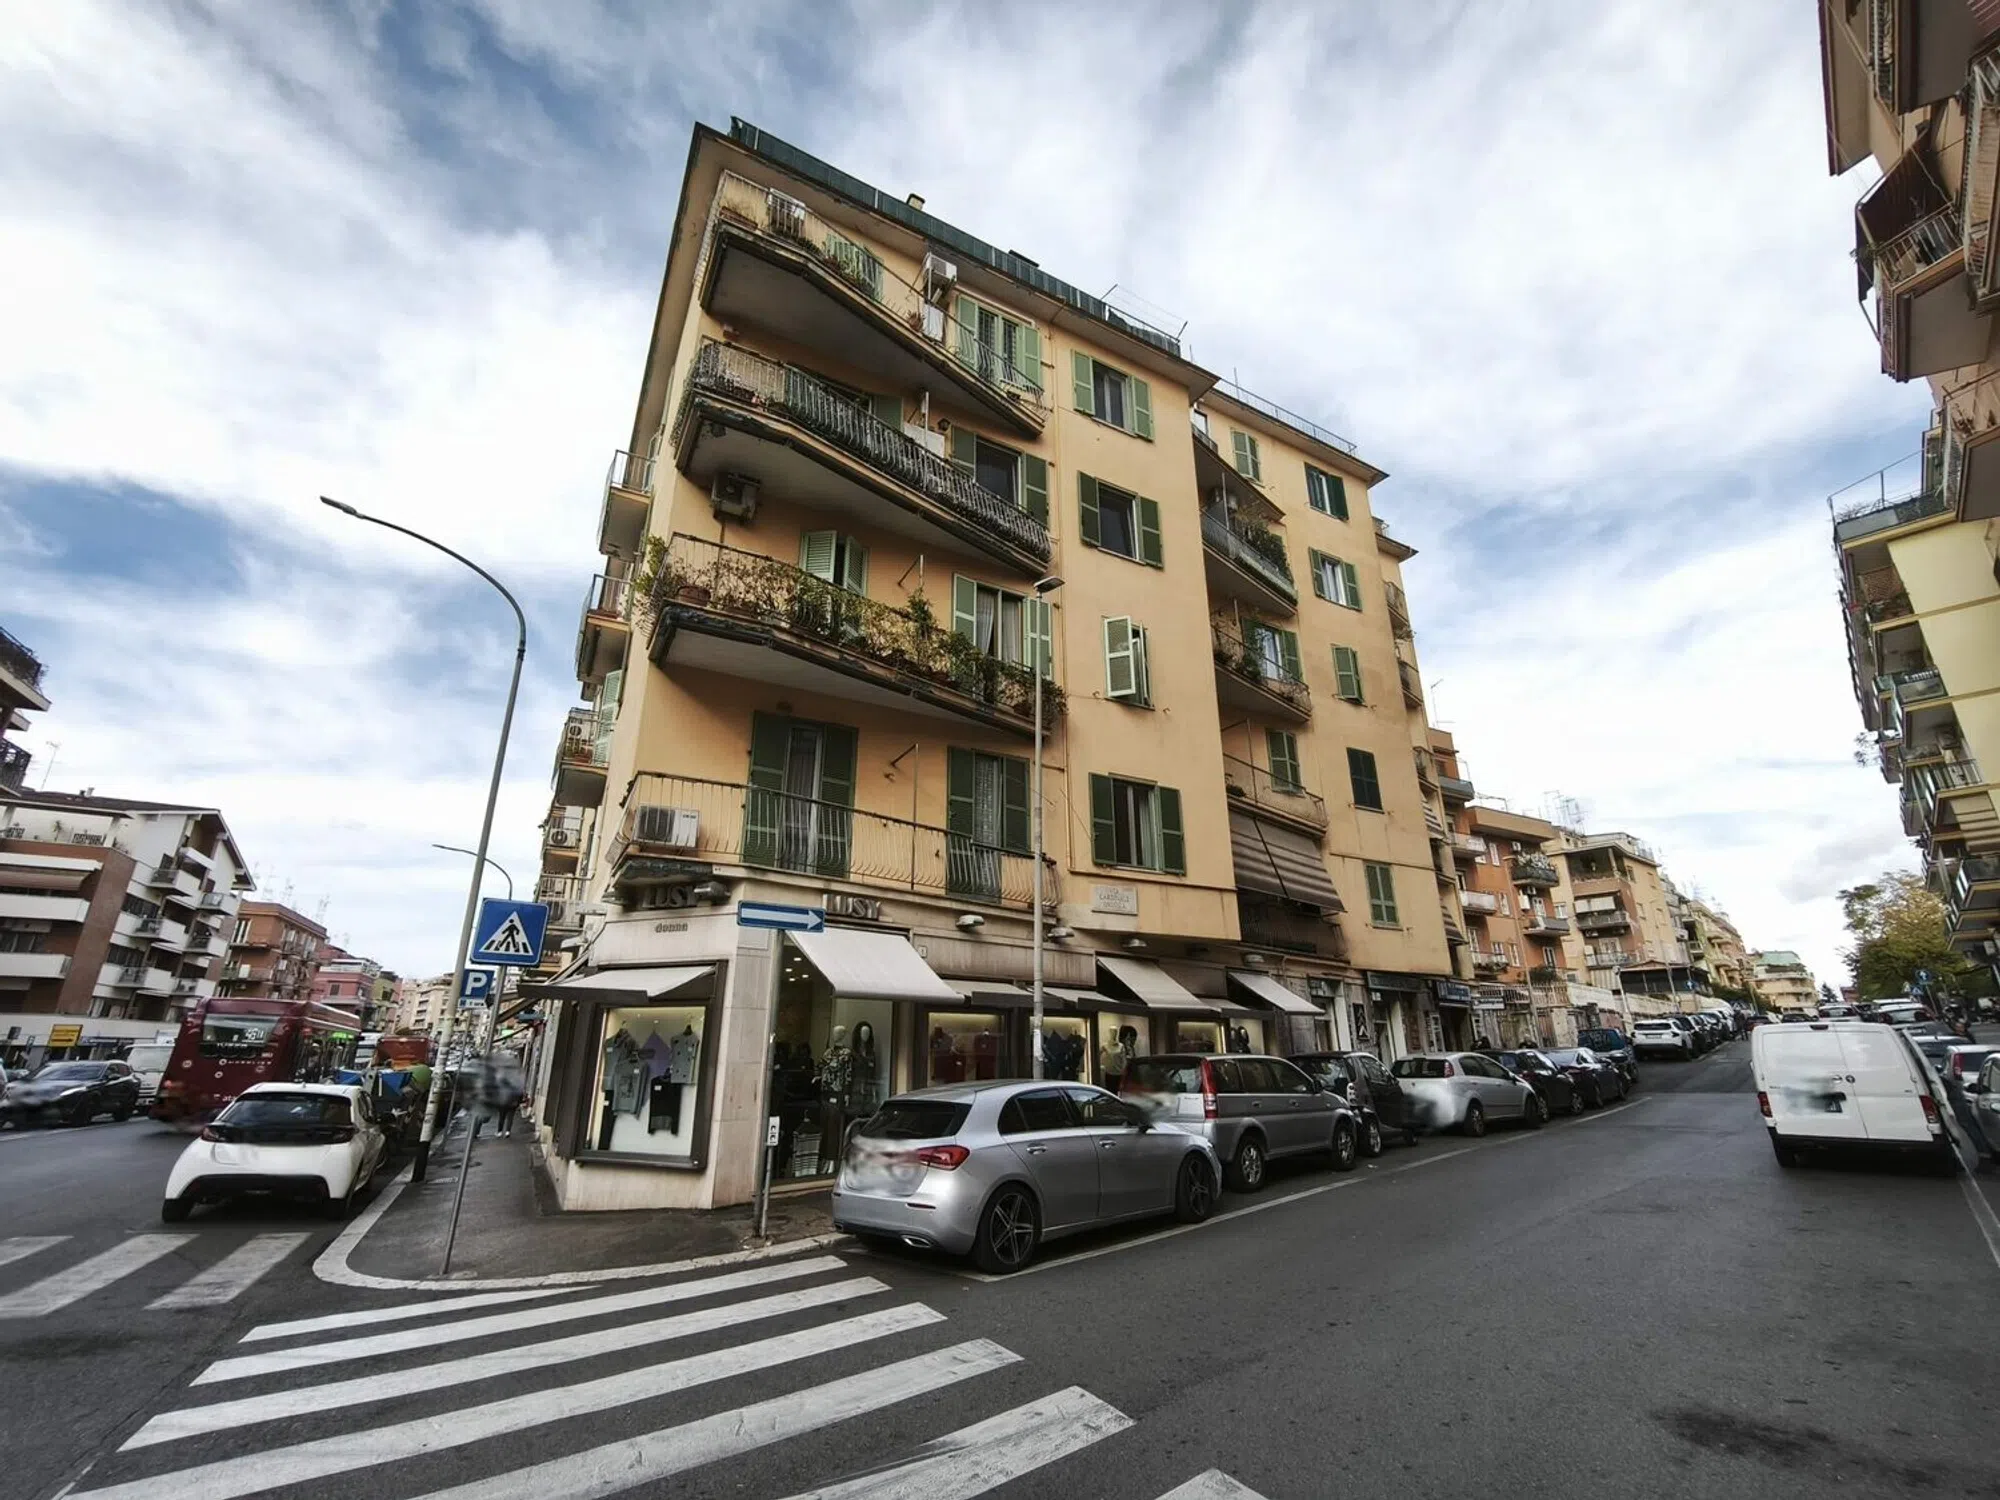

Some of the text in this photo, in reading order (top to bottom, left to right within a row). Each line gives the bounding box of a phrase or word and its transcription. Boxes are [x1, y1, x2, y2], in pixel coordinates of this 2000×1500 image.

[822, 893, 881, 919] LUSY
[655, 922, 688, 933] donna
[465, 971, 488, 995] P
